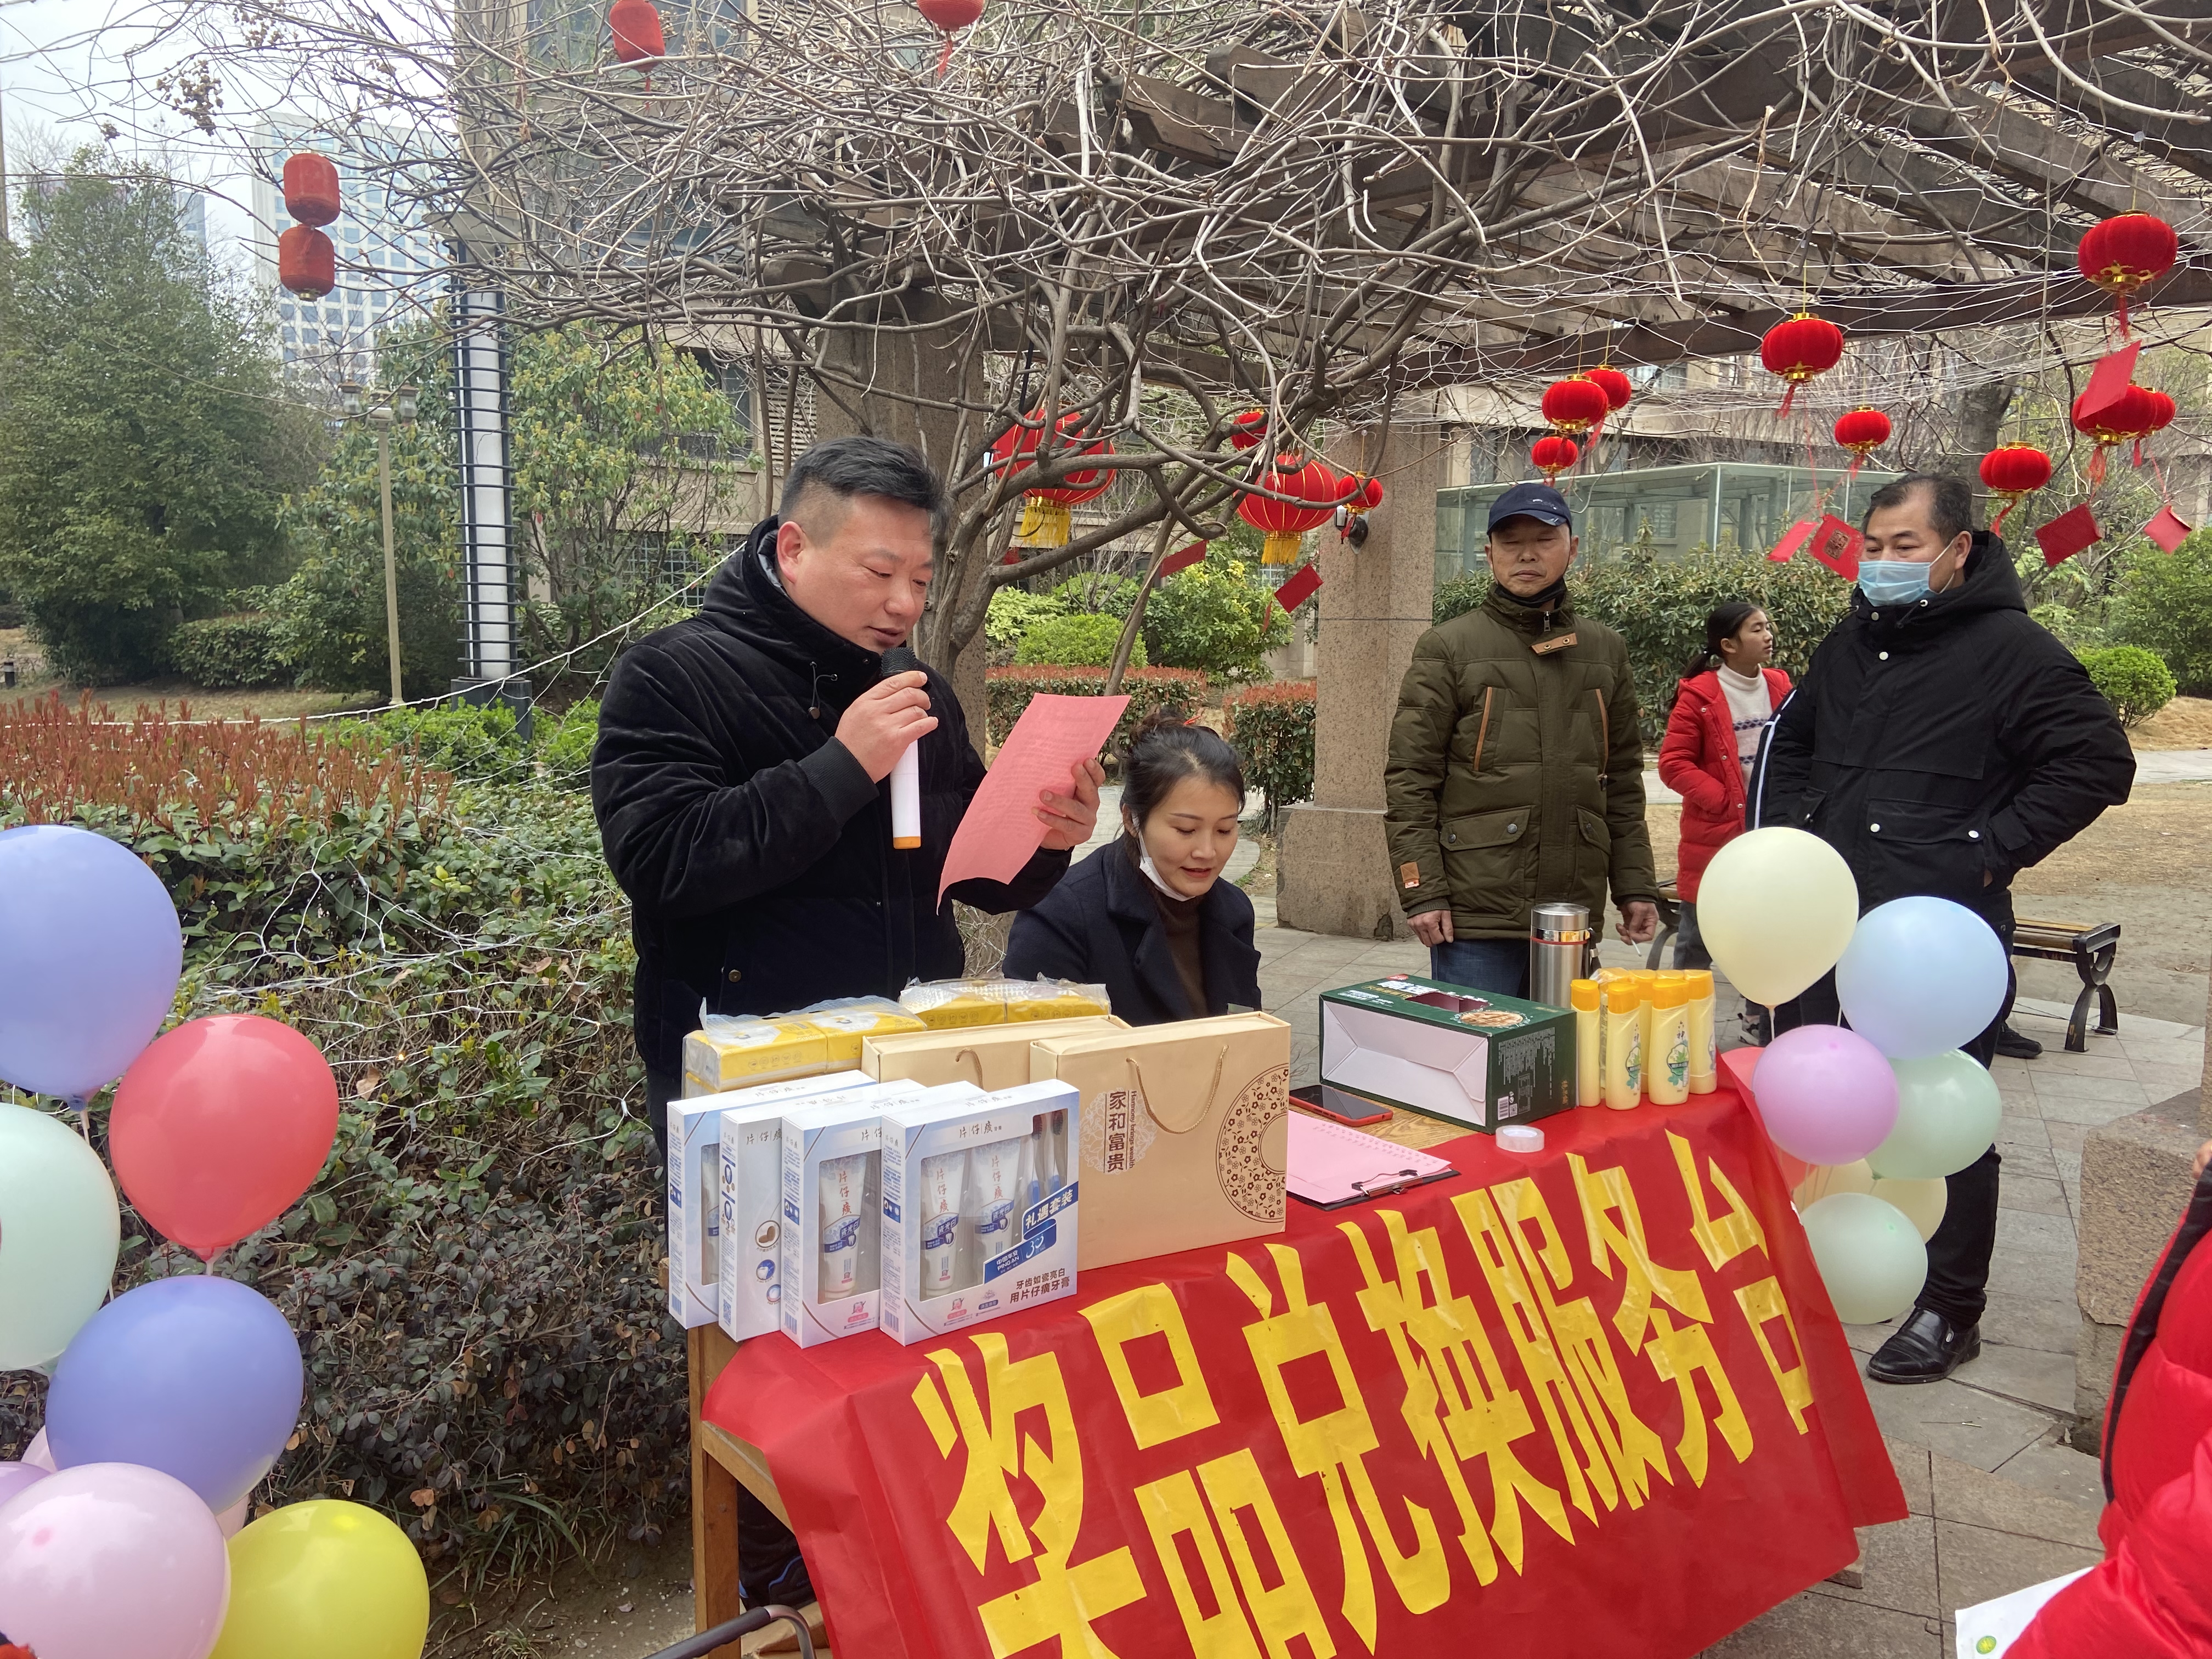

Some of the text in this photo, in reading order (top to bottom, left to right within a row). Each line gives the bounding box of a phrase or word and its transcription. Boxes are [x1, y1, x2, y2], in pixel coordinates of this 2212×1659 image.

[1107, 1091, 1126, 1172] 家和富贵
[1025, 1188, 1074, 1229] 礼遇套装
[996, 1249, 1018, 1265] 中国平安
[1009, 1276, 1070, 1304] 用片仔癀牙膏
[1016, 1267, 1065, 1290] 牙齿如瓷亮白
[912, 1128, 1814, 1658] 奖品兑换服务台
